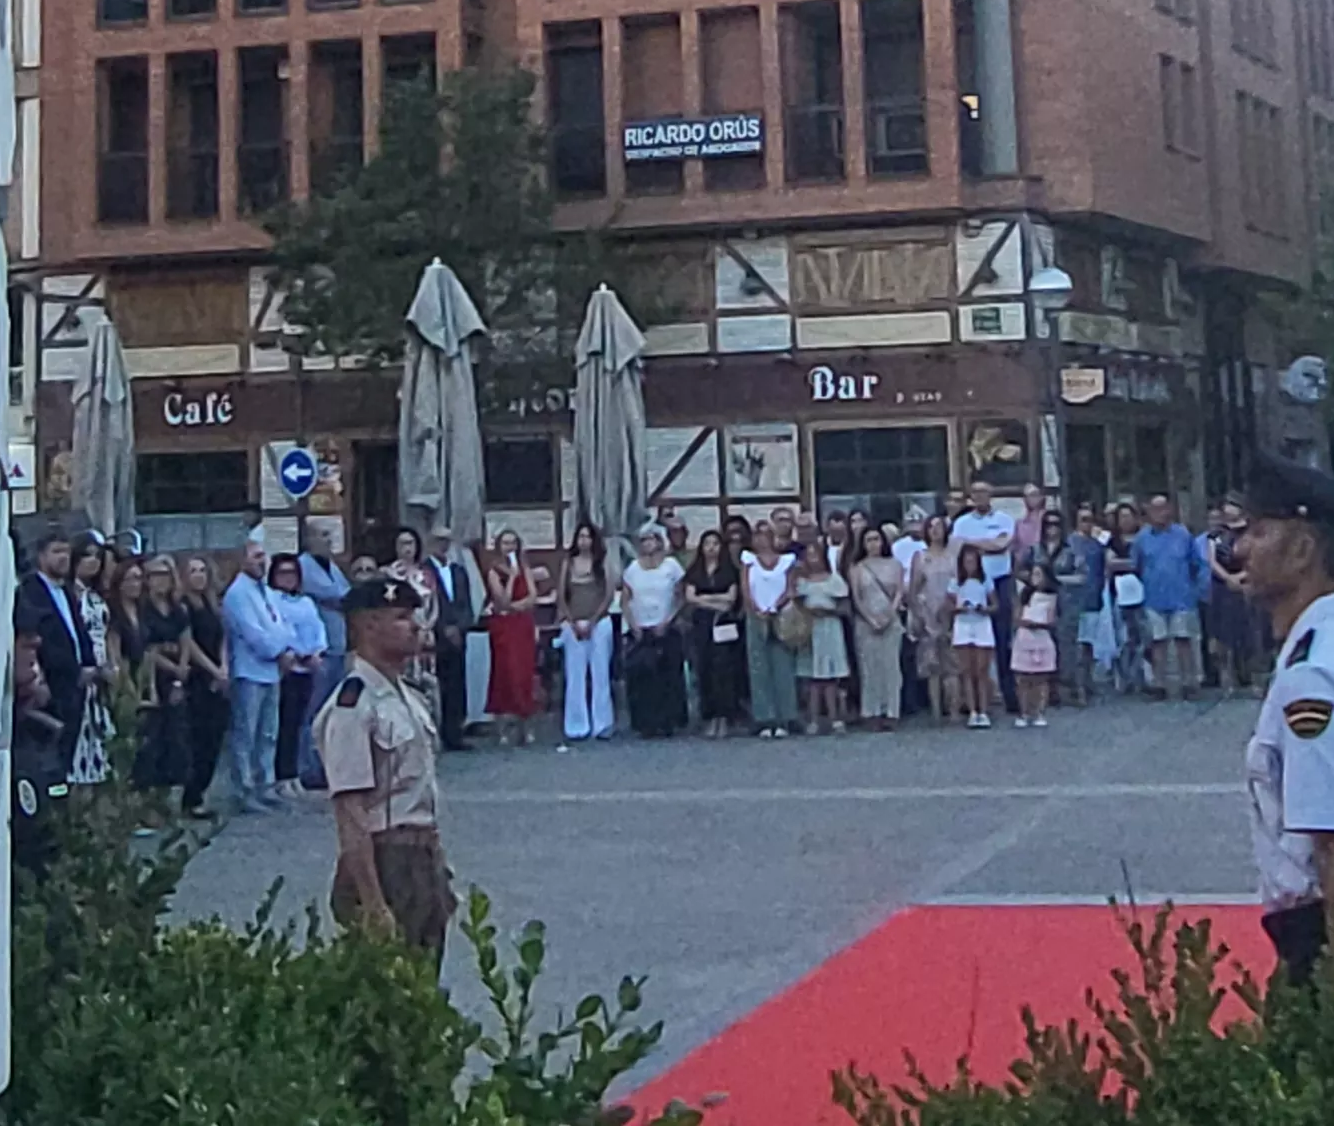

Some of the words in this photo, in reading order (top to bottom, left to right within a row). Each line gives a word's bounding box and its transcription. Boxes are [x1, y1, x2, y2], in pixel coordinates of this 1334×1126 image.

[624, 123, 705, 147] RICARDO
[709, 113, 760, 141] ORÚS
[809, 365, 878, 400] Bar
[164, 392, 233, 425] Café
